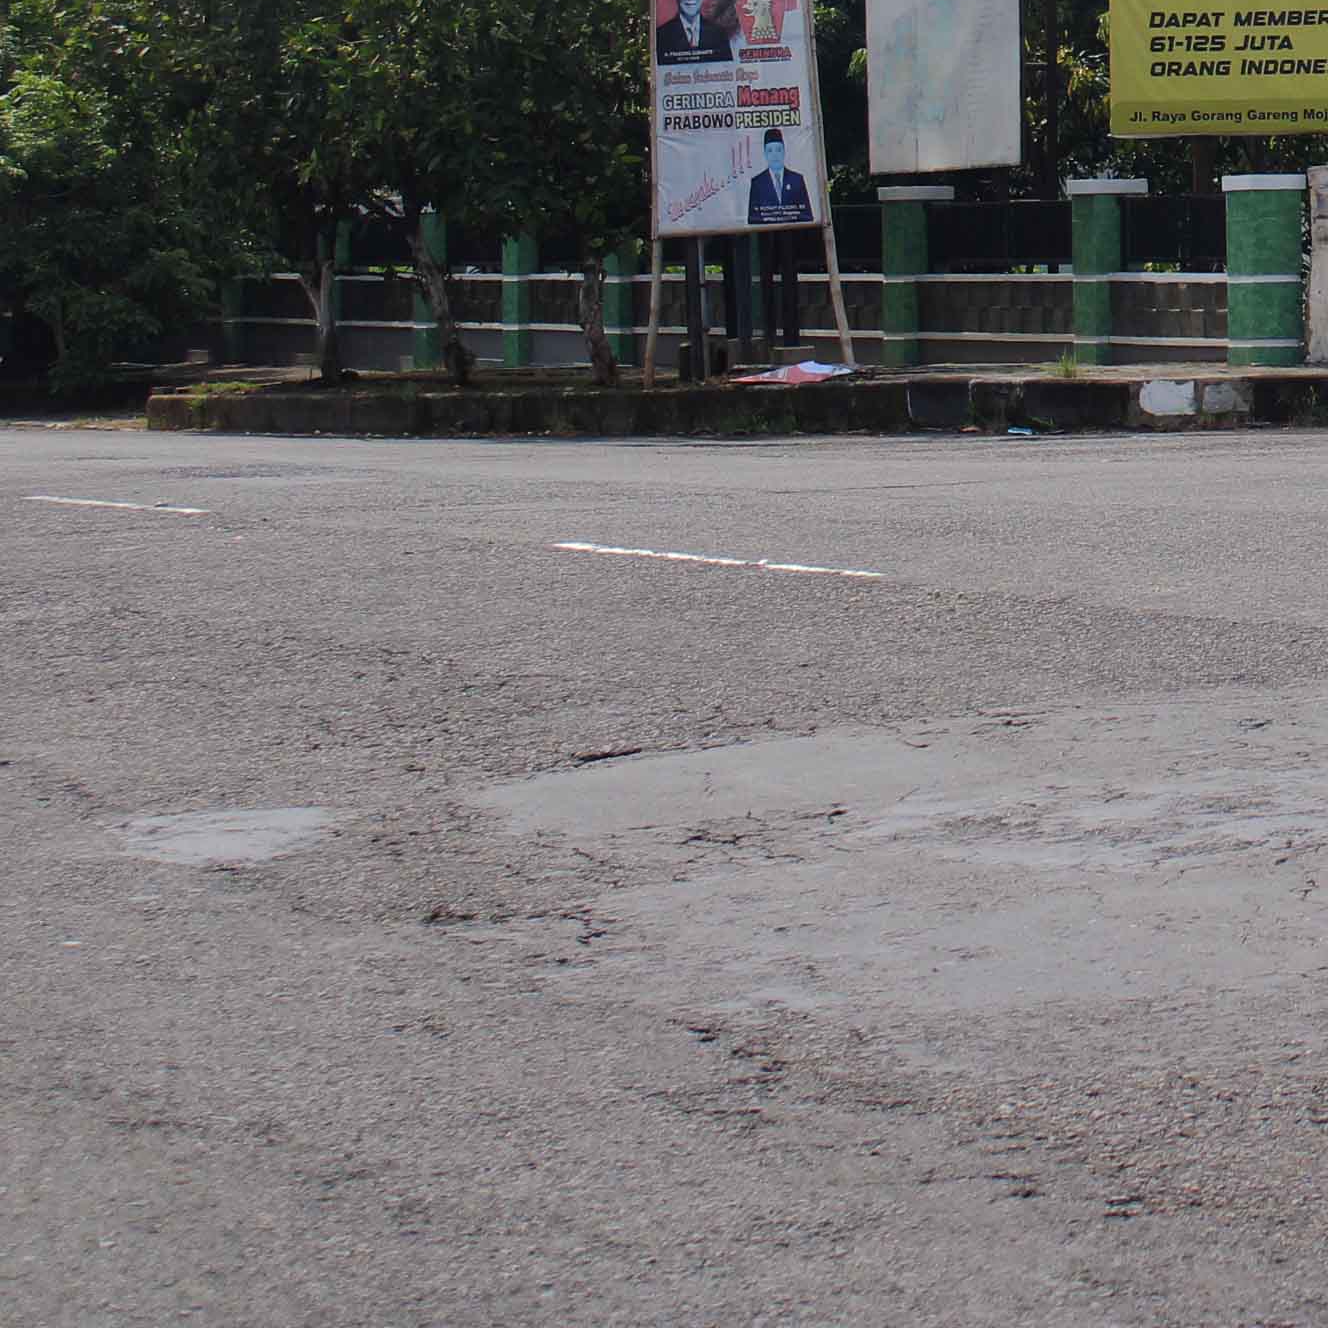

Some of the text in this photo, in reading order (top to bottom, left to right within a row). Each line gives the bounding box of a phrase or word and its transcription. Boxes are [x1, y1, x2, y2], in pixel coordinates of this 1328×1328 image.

[1149, 11, 1225, 28] DAPAT
[1150, 33, 1294, 52] 61-125 JUTA
[1150, 60, 1231, 77] ORANG
[663, 85, 800, 111] GERINDRA Menang
[664, 109, 801, 130] PRABOWO PRESIDEN
[1129, 110, 1148, 123] Jl.
[1152, 110, 1187, 125] Raya
[1190, 110, 1242, 124] Gorang
[1247, 108, 1298, 123] Gareng
